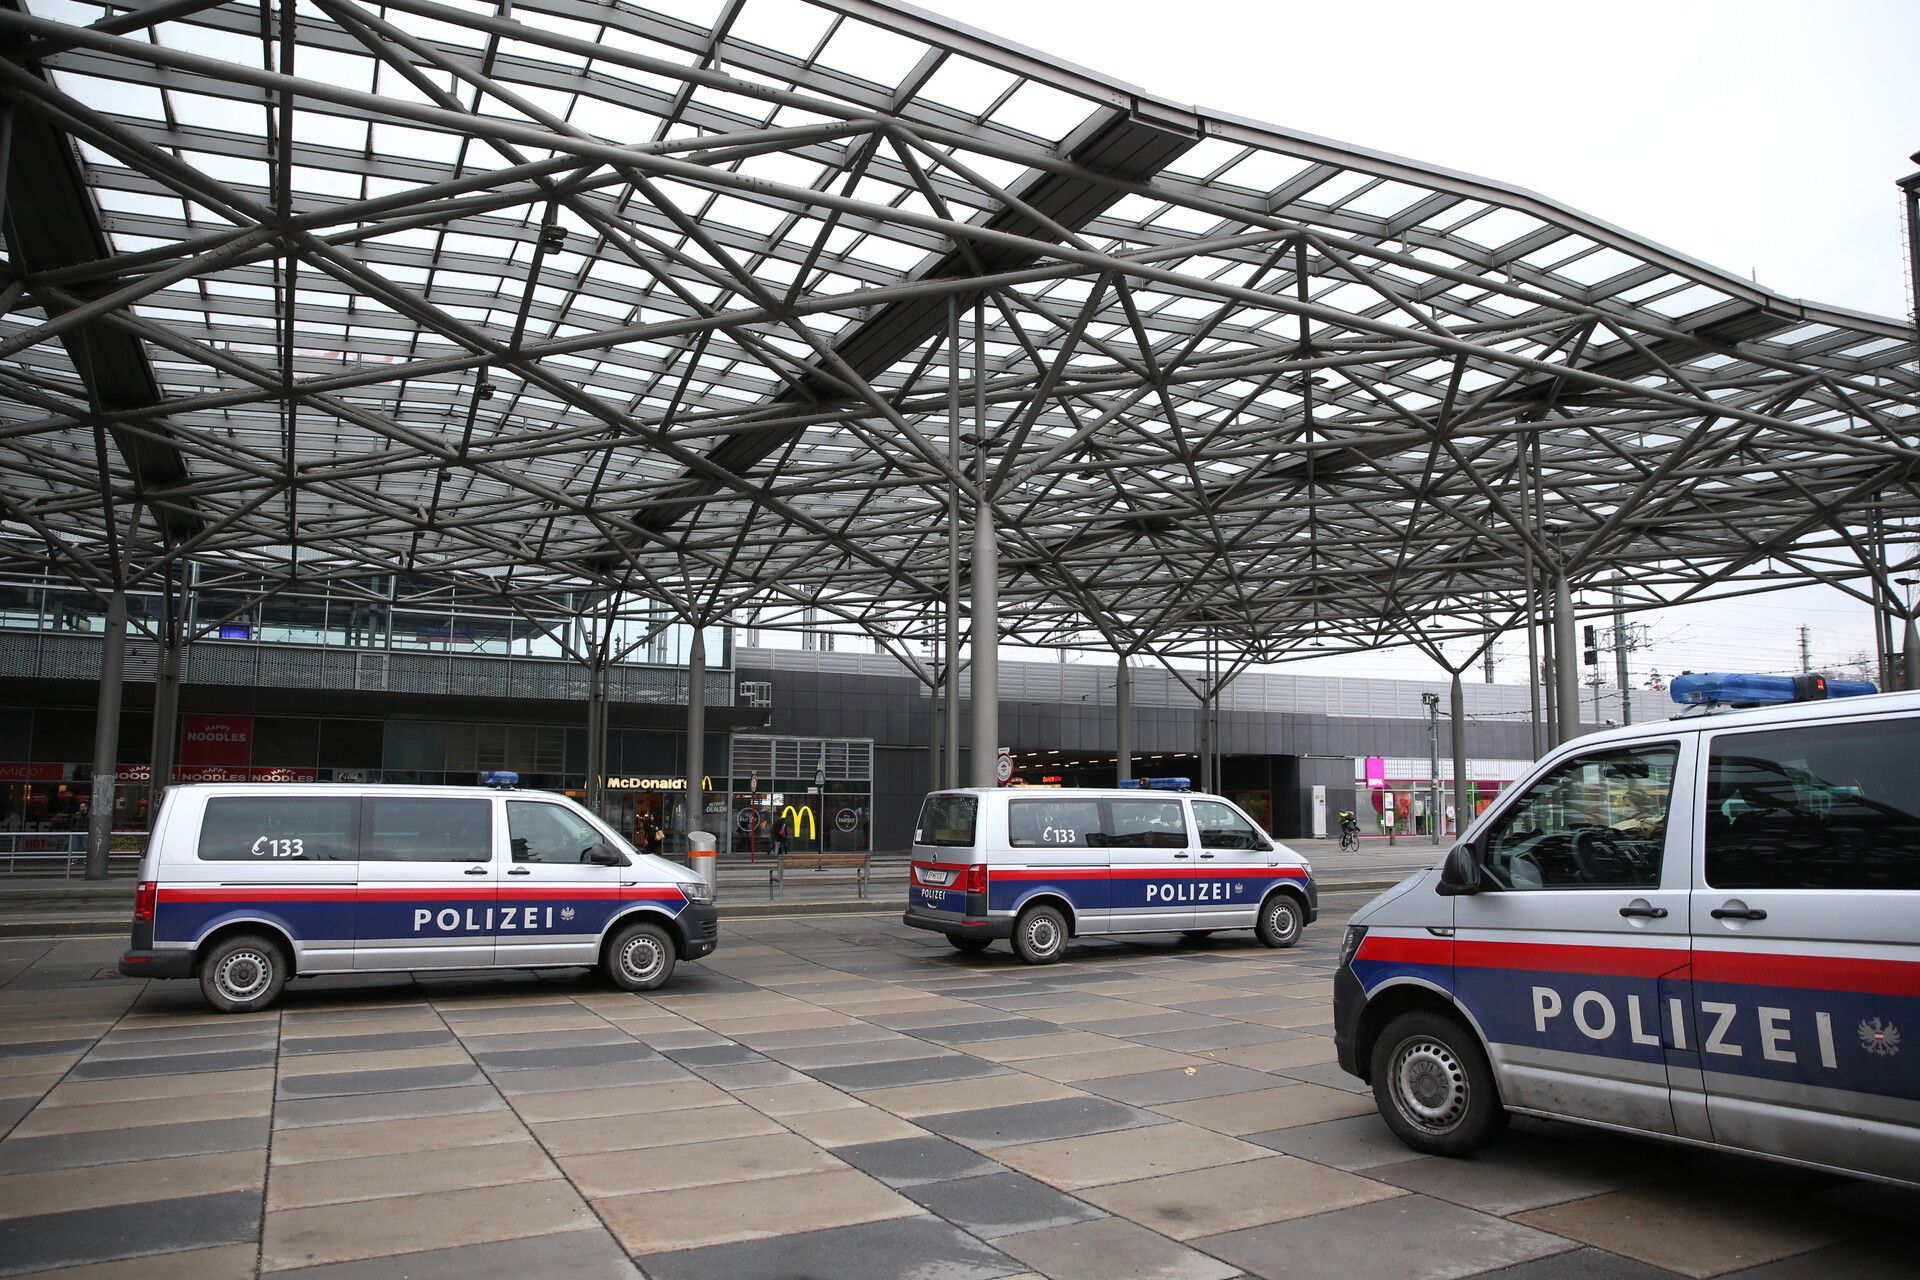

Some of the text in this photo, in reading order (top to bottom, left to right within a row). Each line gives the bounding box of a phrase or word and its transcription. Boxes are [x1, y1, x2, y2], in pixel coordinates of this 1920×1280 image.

[187, 732, 247, 742] NOODLES
[182, 773, 246, 782] NOODLES
[252, 774, 314, 783] NOODLES
[1053, 829, 1076, 843] 133
[269, 838, 304, 857] 133
[921, 888, 946, 900] POLIZEI
[1146, 882, 1231, 902] POLIZEI
[413, 906, 553, 932] POLIZEI
[1531, 986, 1838, 1069] POLIZEI
